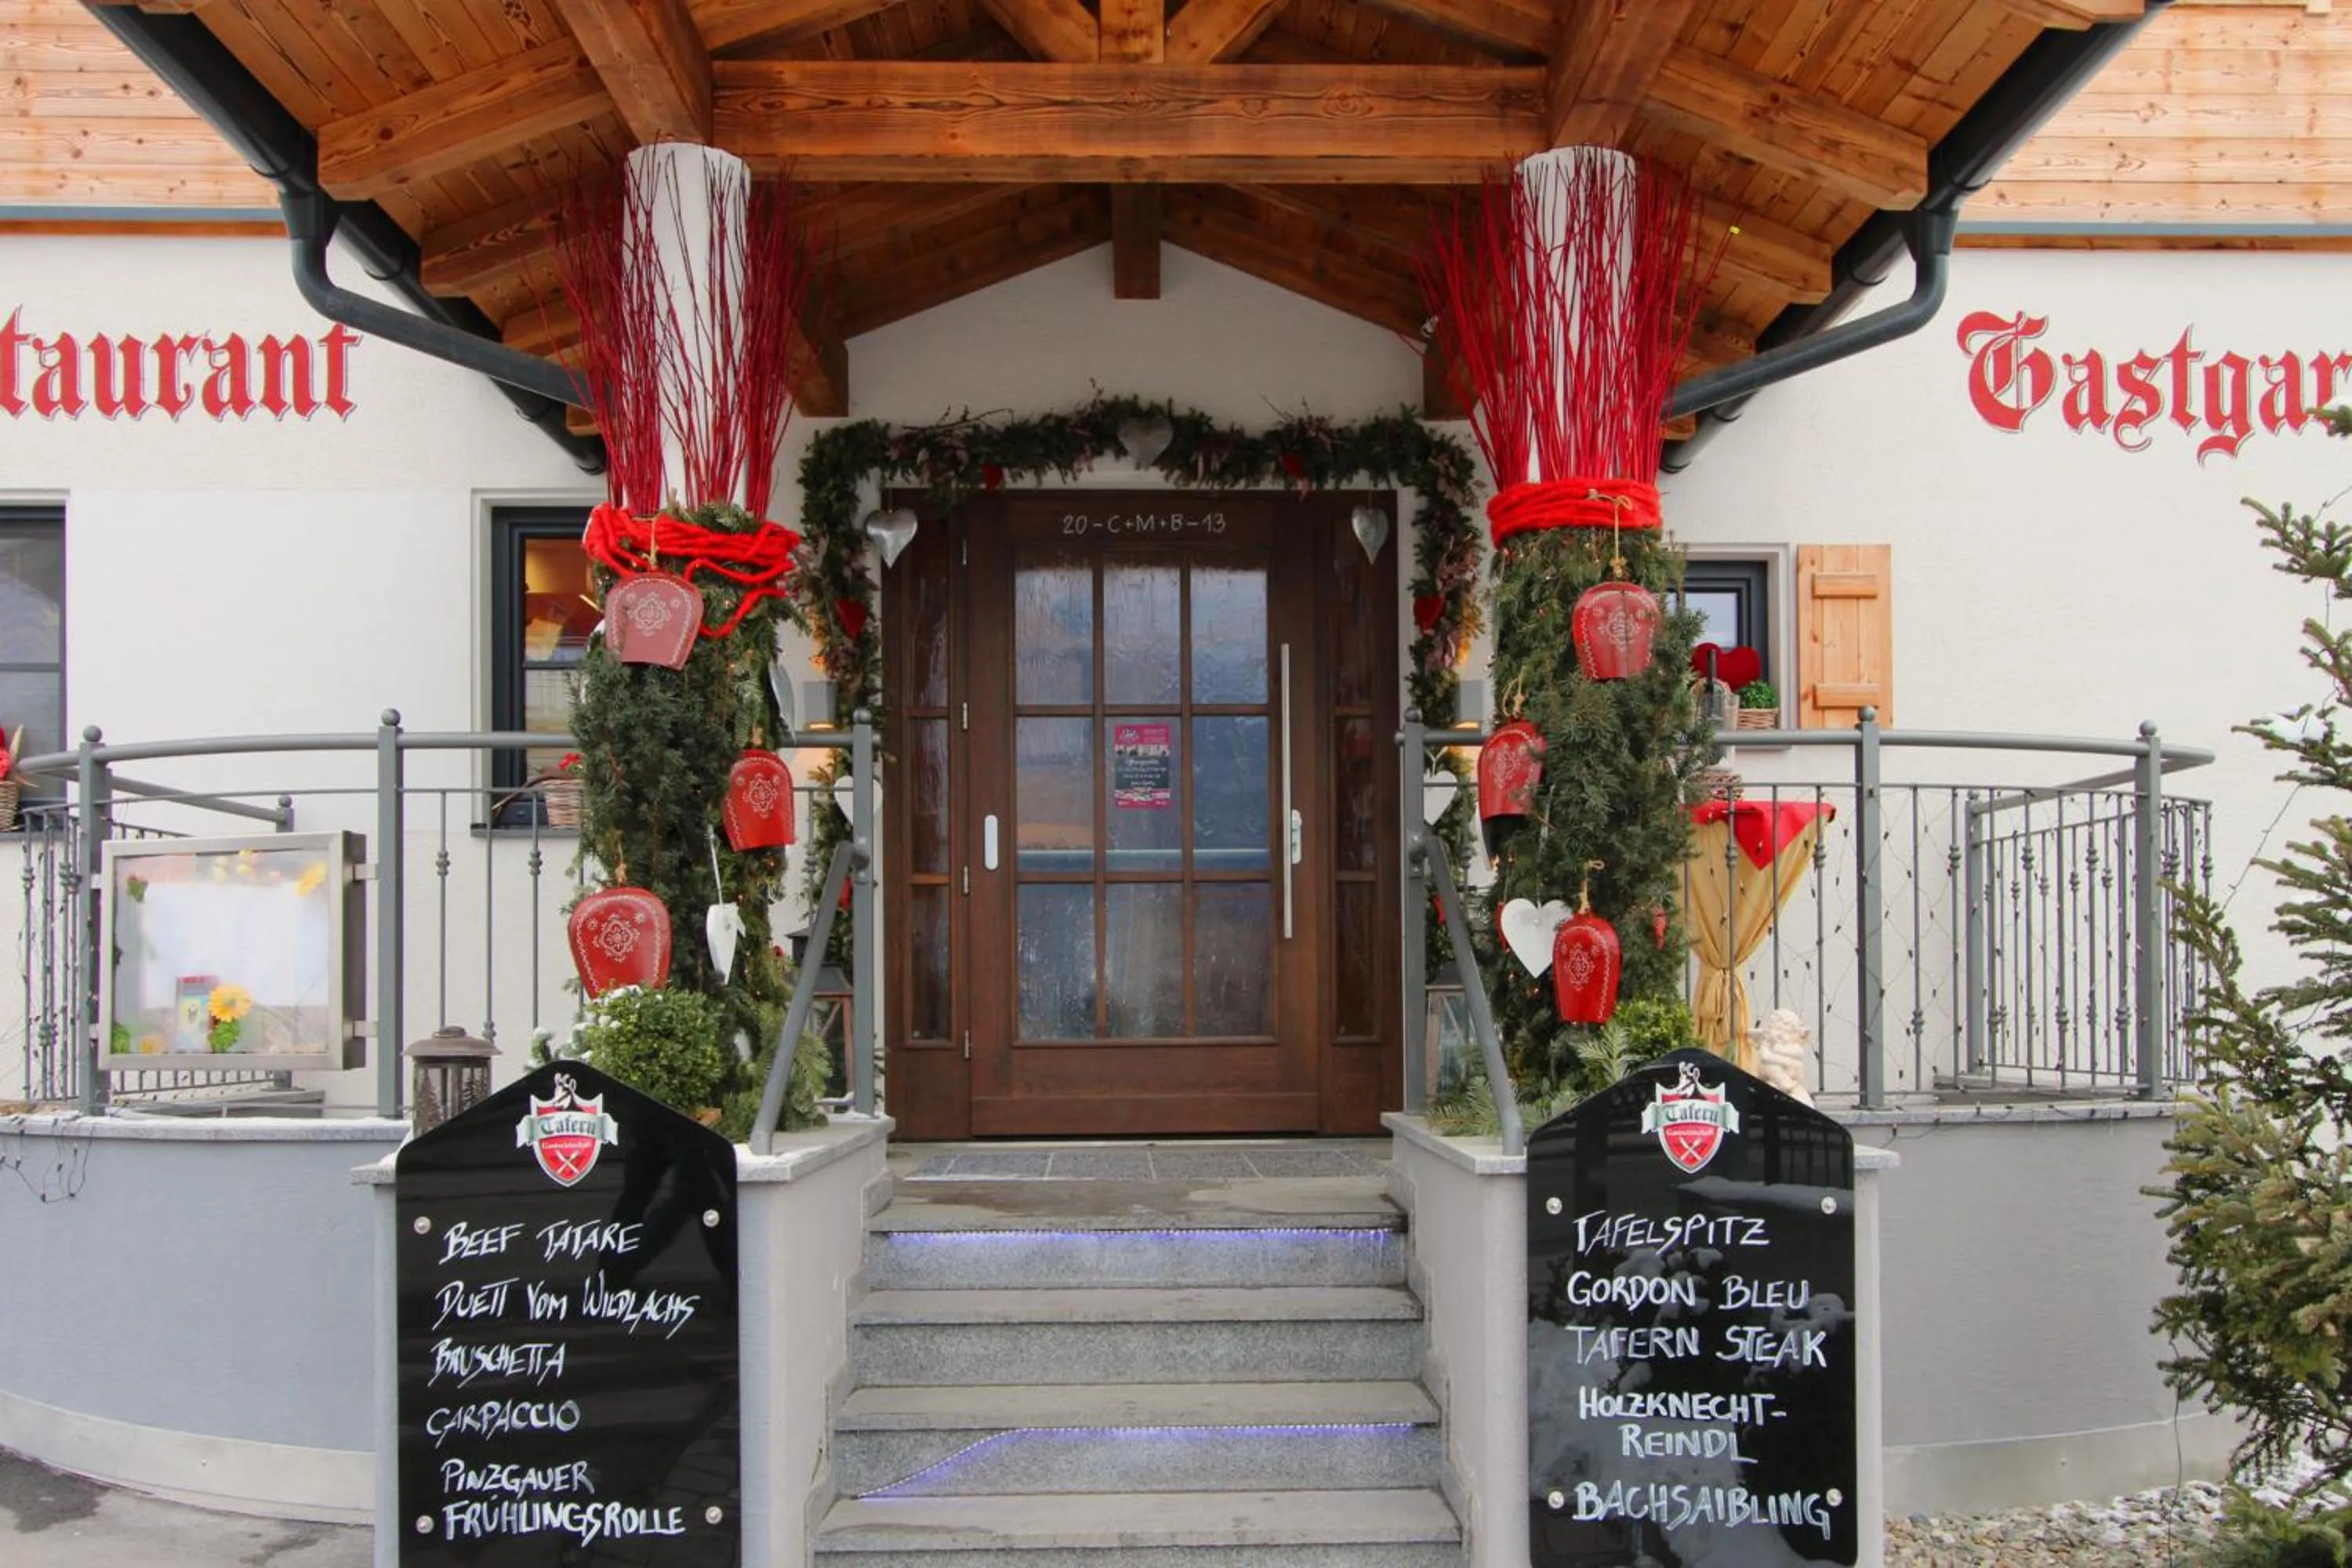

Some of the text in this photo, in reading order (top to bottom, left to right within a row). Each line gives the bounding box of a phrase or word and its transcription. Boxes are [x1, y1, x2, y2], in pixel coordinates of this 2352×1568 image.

[0, 304, 363, 422] taurant
[539, 1114, 595, 1135] Tafern
[1661, 1102, 1719, 1123] Tafern
[439, 1219, 644, 1265] BEEF TATARE
[1573, 1210, 1769, 1256] TAFELSPITZ
[432, 1277, 519, 1330] DUETT
[1567, 1271, 1809, 1312] GORDON BLEU
[1566, 1325, 1827, 1367] TAFERN STEAK
[426, 1399, 581, 1449] CARPACCIO
[1579, 1386, 1787, 1425] HOLZKNECHT-
[1618, 1423, 1759, 1464] REINDL
[441, 1459, 594, 1499] PINZGAUER
[1573, 1479, 1831, 1540] BACHSAIBLING
